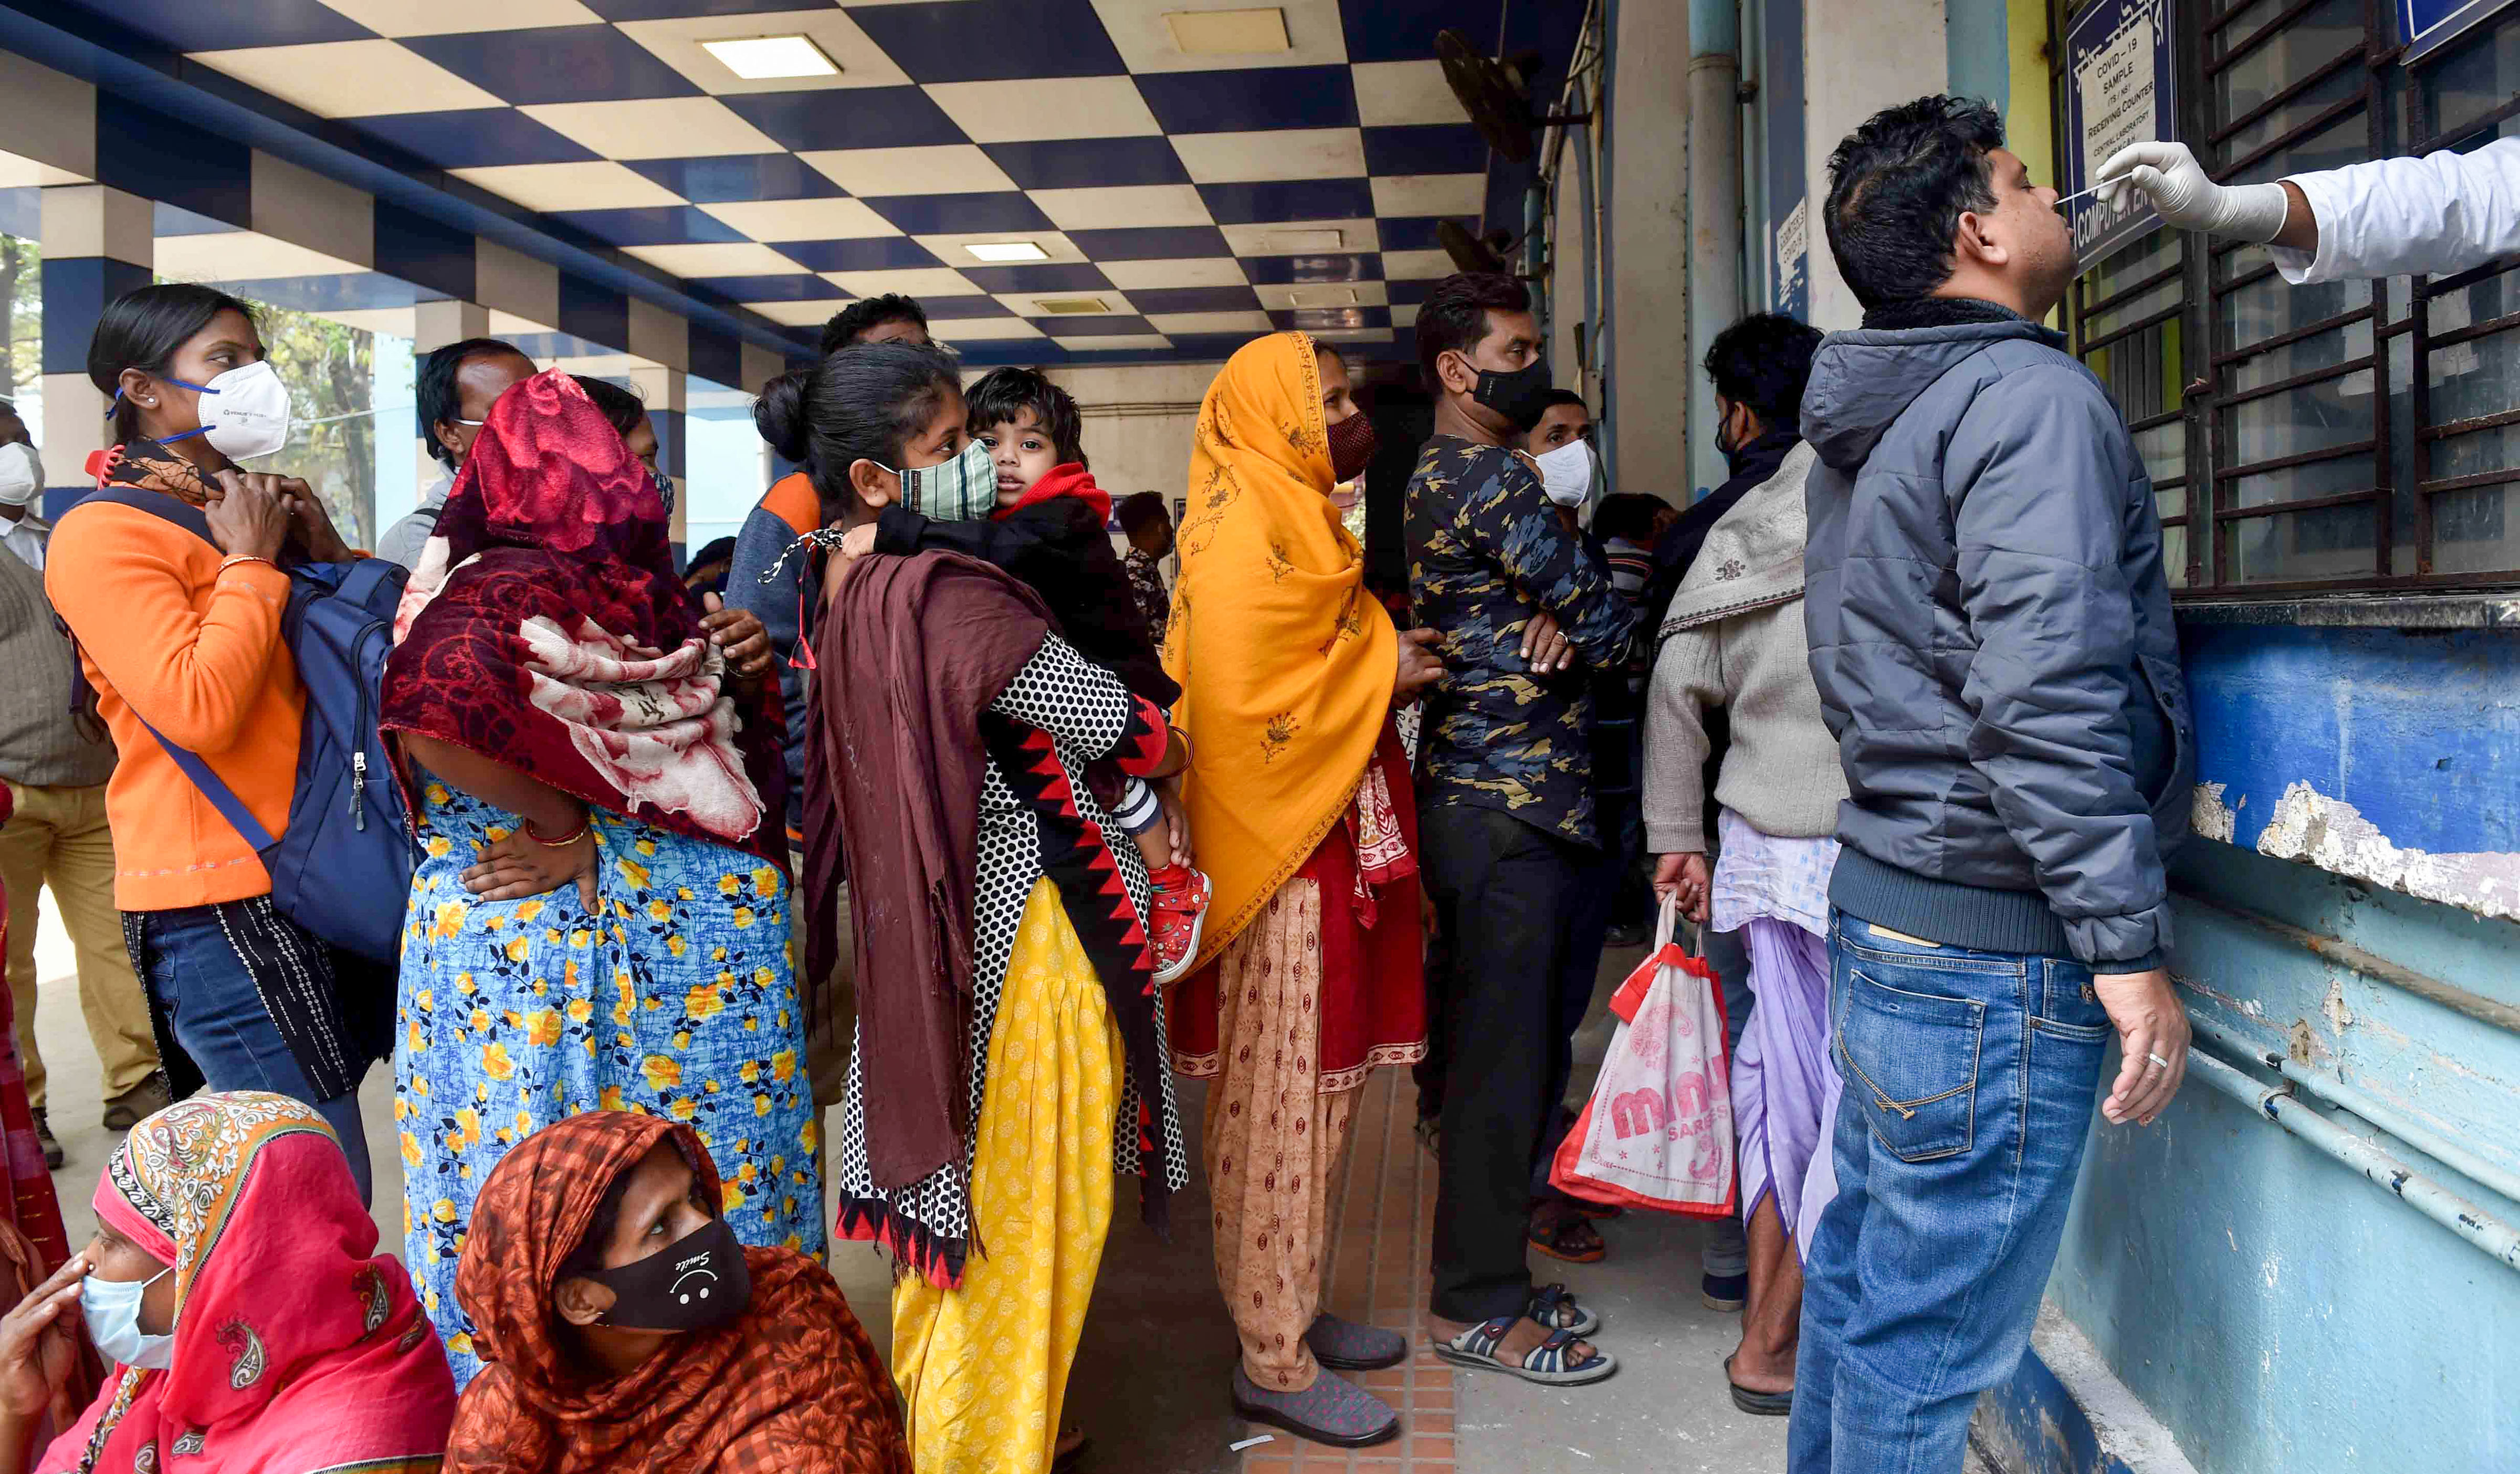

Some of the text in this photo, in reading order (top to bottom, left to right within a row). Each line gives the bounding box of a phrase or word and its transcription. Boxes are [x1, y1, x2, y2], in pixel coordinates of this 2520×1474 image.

[2097, 53, 2119, 78] COVID
[2104, 61, 2133, 94] SAMPLE
[2088, 81, 2153, 139] RECEIVING COUNTER
[2094, 109, 2149, 157] CENTRAL LABORATORY
[2078, 193, 2131, 247] COMPU
[676, 1251, 710, 1272] Smile
